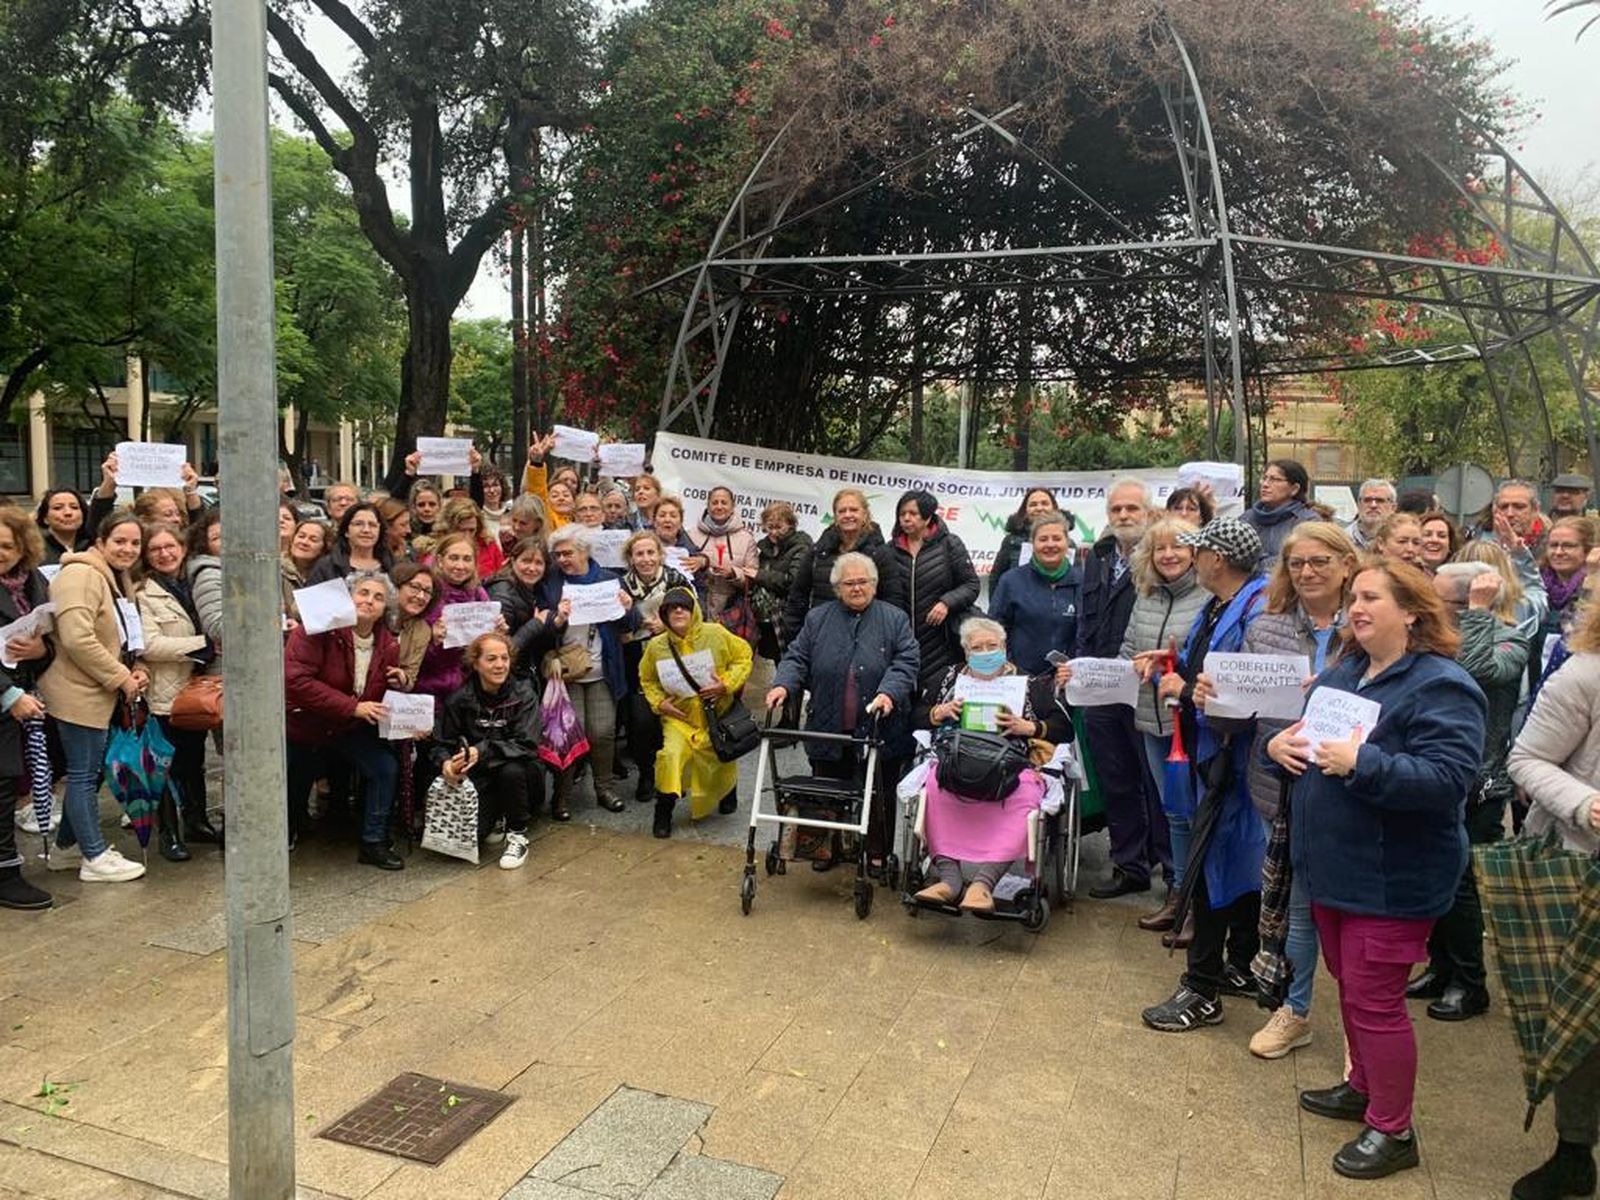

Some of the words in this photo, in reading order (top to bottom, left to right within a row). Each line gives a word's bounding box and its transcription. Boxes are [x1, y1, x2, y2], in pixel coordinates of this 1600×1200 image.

[671, 447, 726, 465] COMITÉ
[731, 455, 750, 468] DE
[754, 458, 824, 479] EMPRESA
[829, 469, 848, 482] DE
[999, 486, 1083, 499] JUVTUD
[684, 488, 752, 507] COBRA
[742, 508, 756, 520] DE
[1220, 660, 1296, 673] COBERTURA
[1217, 673, 1233, 684] DE
[1236, 674, 1302, 687] VACANTES
